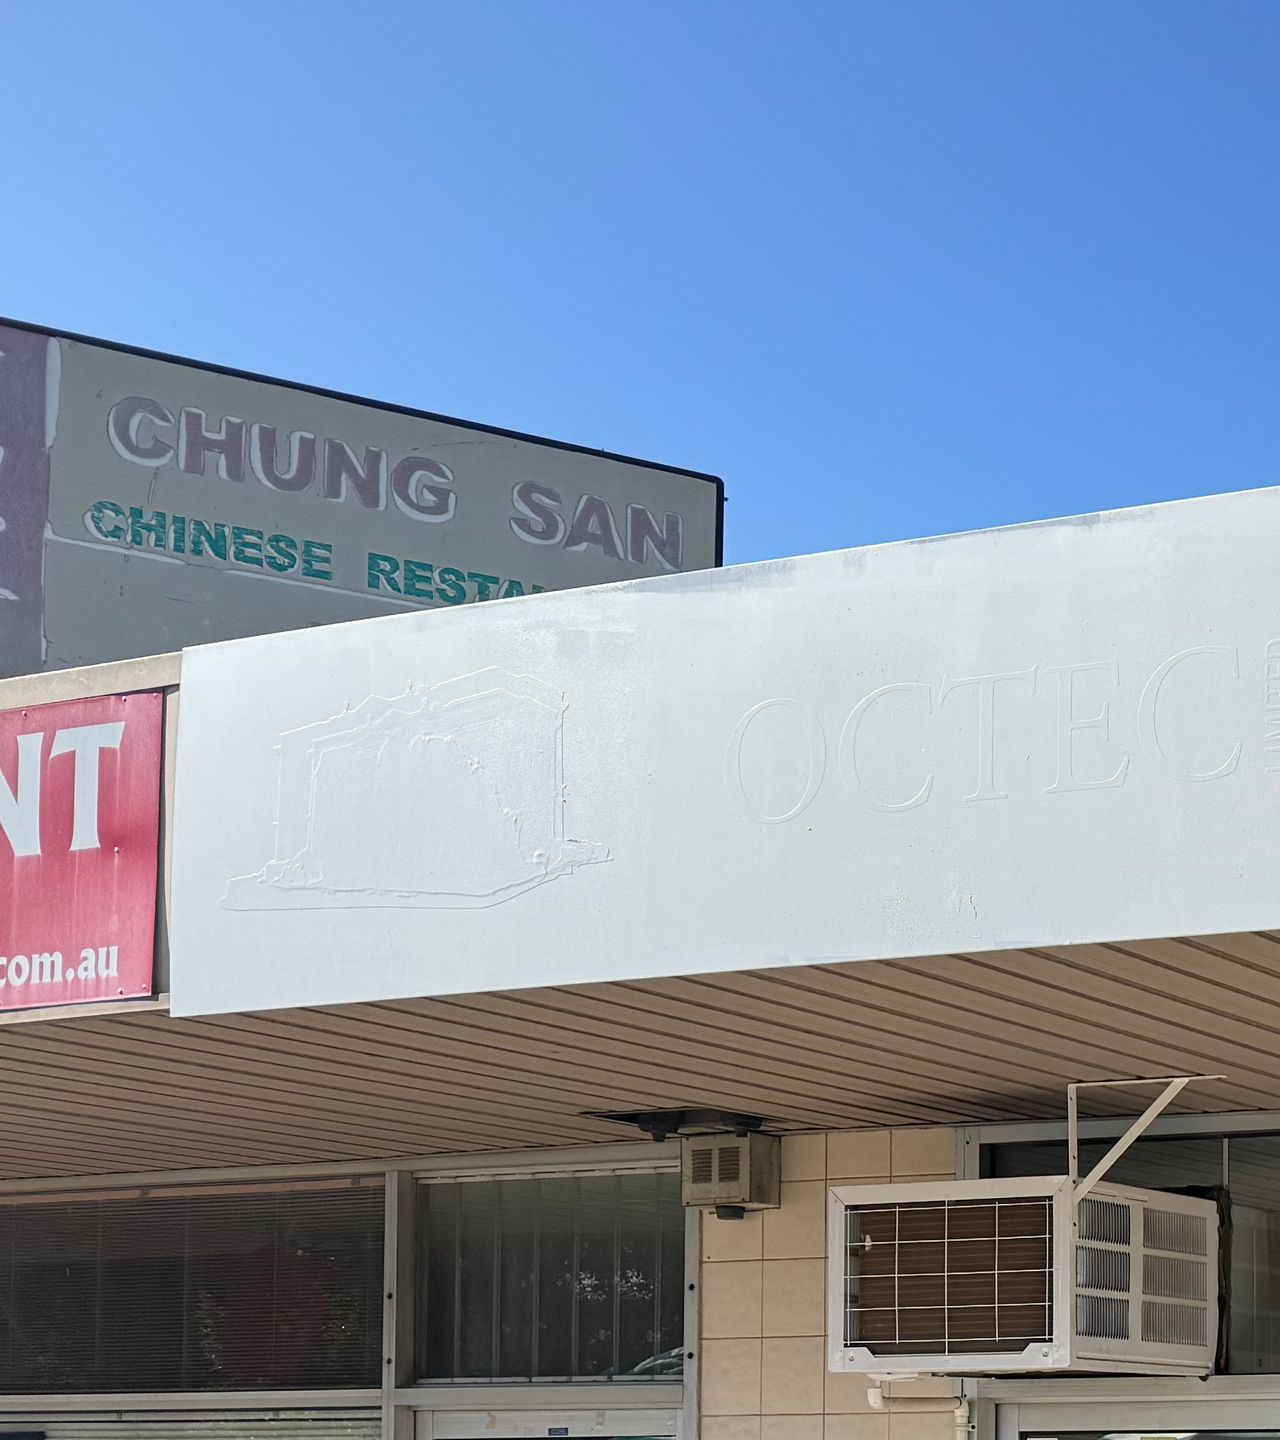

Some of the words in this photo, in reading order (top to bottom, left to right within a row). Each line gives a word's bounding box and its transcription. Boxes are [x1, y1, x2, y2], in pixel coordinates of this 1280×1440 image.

[84, 501, 333, 581] CHINESE
[108, 396, 458, 524] CHUNG
[509, 480, 684, 571] SAN
[726, 643, 1243, 825] OCTEC
